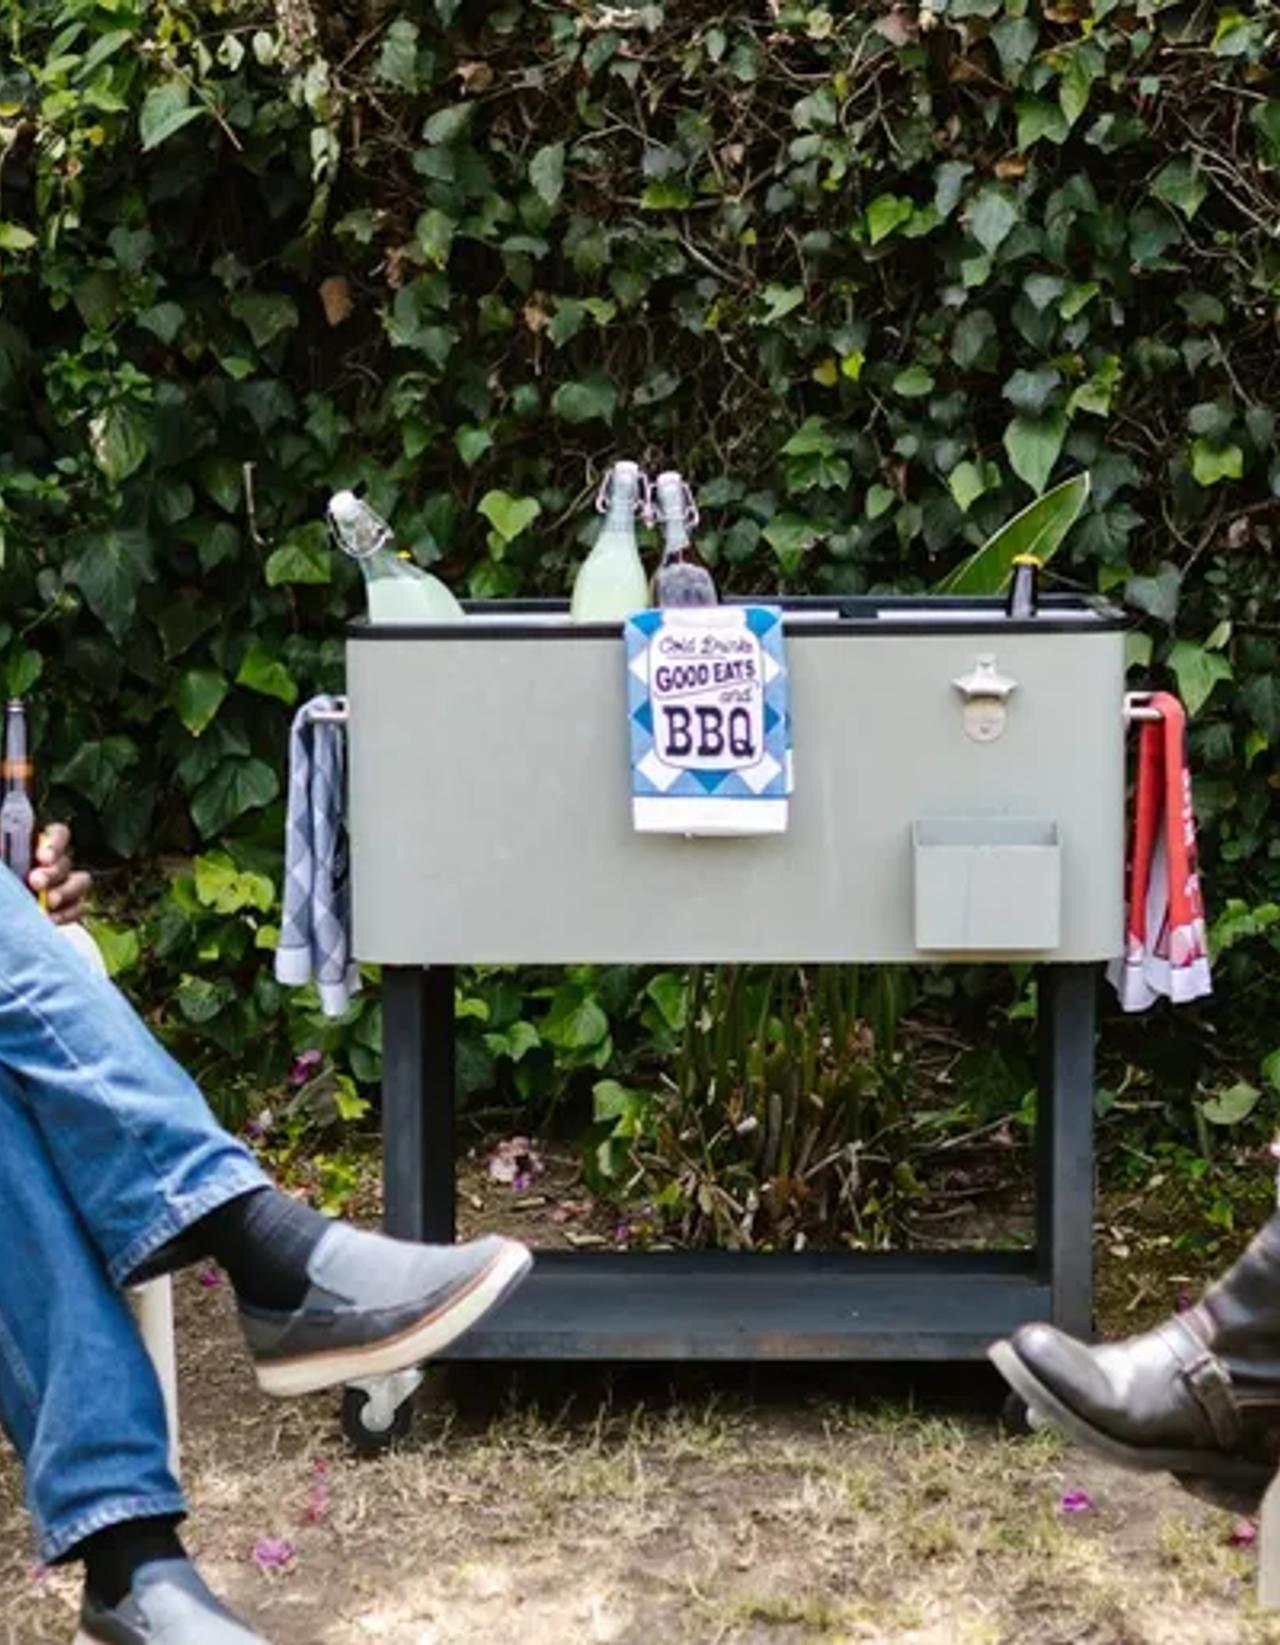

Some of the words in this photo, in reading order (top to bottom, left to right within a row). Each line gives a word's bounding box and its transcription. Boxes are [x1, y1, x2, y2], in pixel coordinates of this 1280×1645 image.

[659, 636, 696, 655] Cold
[701, 634, 754, 655] Drinks
[656, 664, 709, 693] GOOD
[713, 659, 756, 683] EATS
[719, 688, 752, 703] and
[662, 704, 756, 758] BBQ
